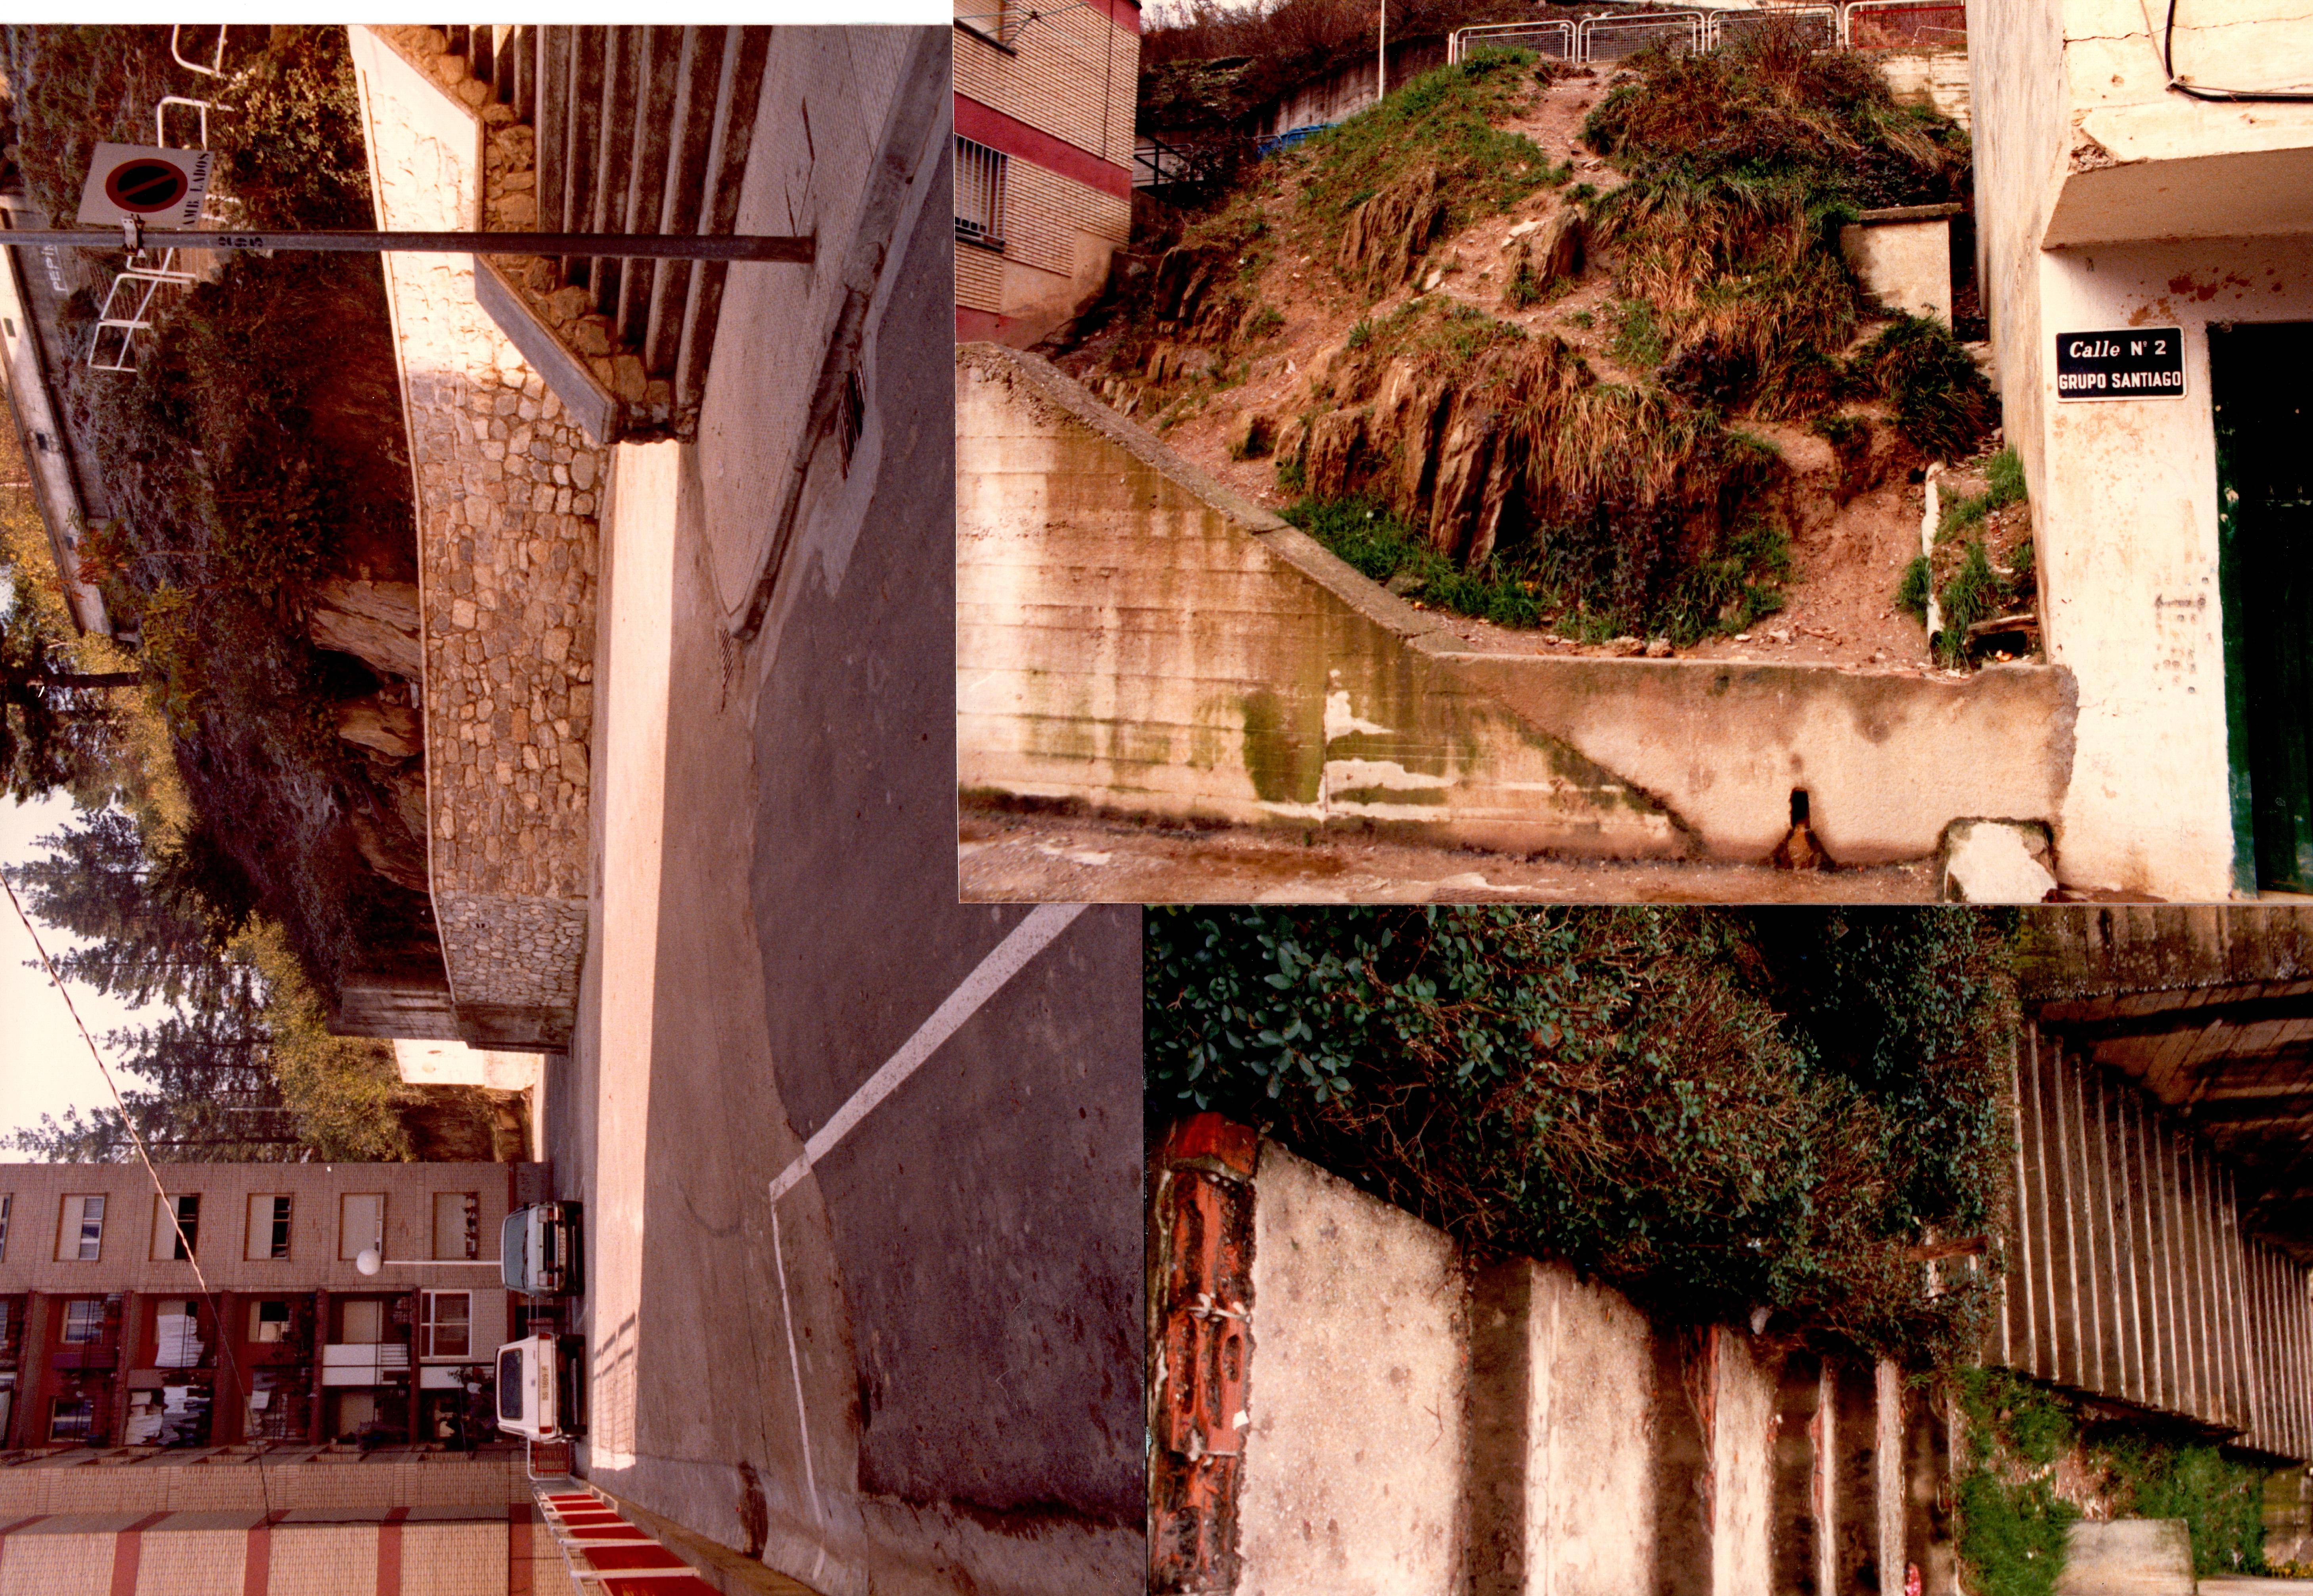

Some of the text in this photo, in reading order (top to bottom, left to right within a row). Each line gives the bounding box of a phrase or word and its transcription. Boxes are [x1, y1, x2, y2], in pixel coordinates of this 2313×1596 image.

[190, 153, 209, 192] LADOS
[2070, 340, 2120, 358] Calle
[2154, 340, 2166, 355] 2
[2059, 371, 2181, 389] GRUPO SANTIAGO
